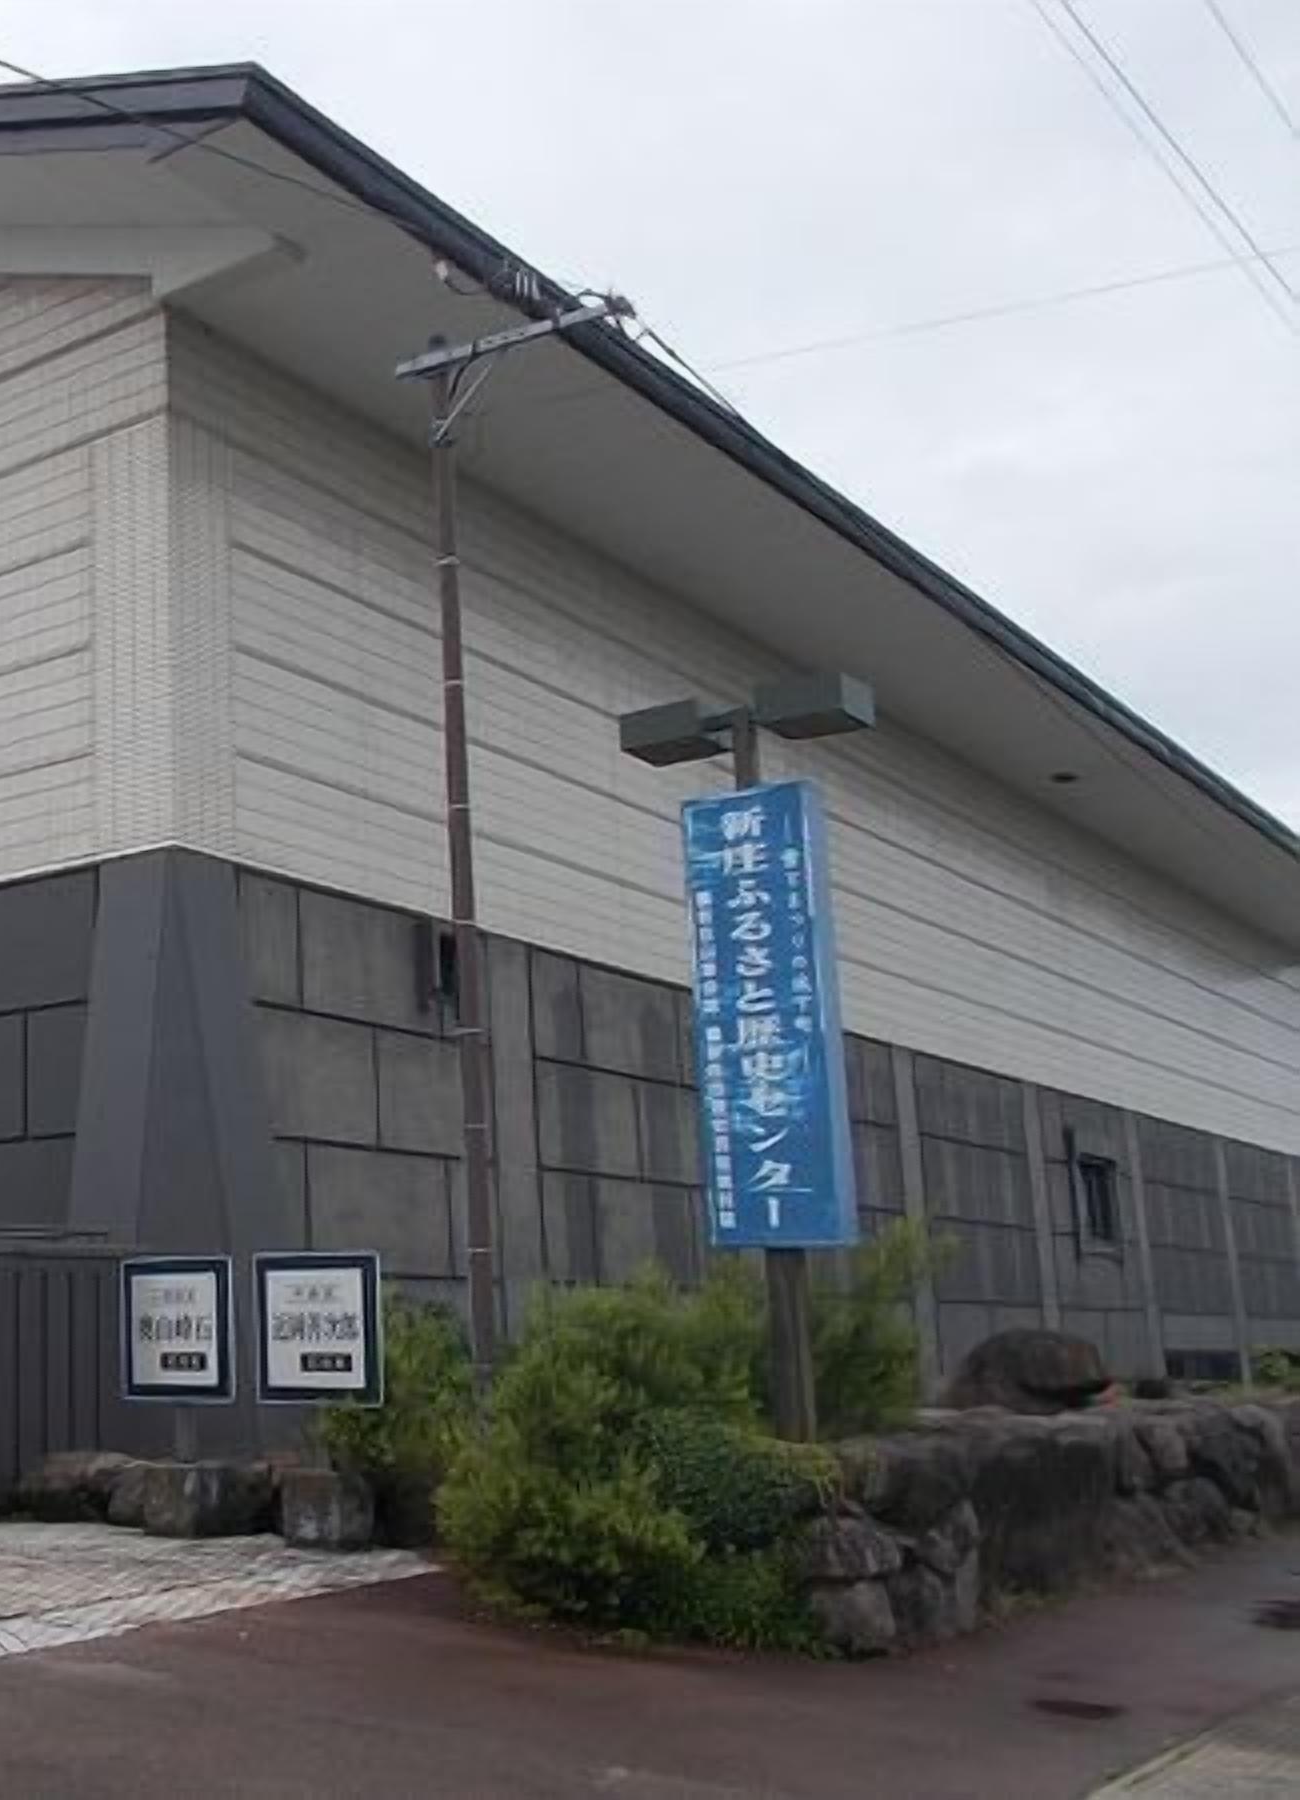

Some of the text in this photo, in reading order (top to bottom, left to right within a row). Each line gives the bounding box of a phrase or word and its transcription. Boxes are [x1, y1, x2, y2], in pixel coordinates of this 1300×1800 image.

[721, 805, 793, 1228] 新庄ふるさと歴史センター
